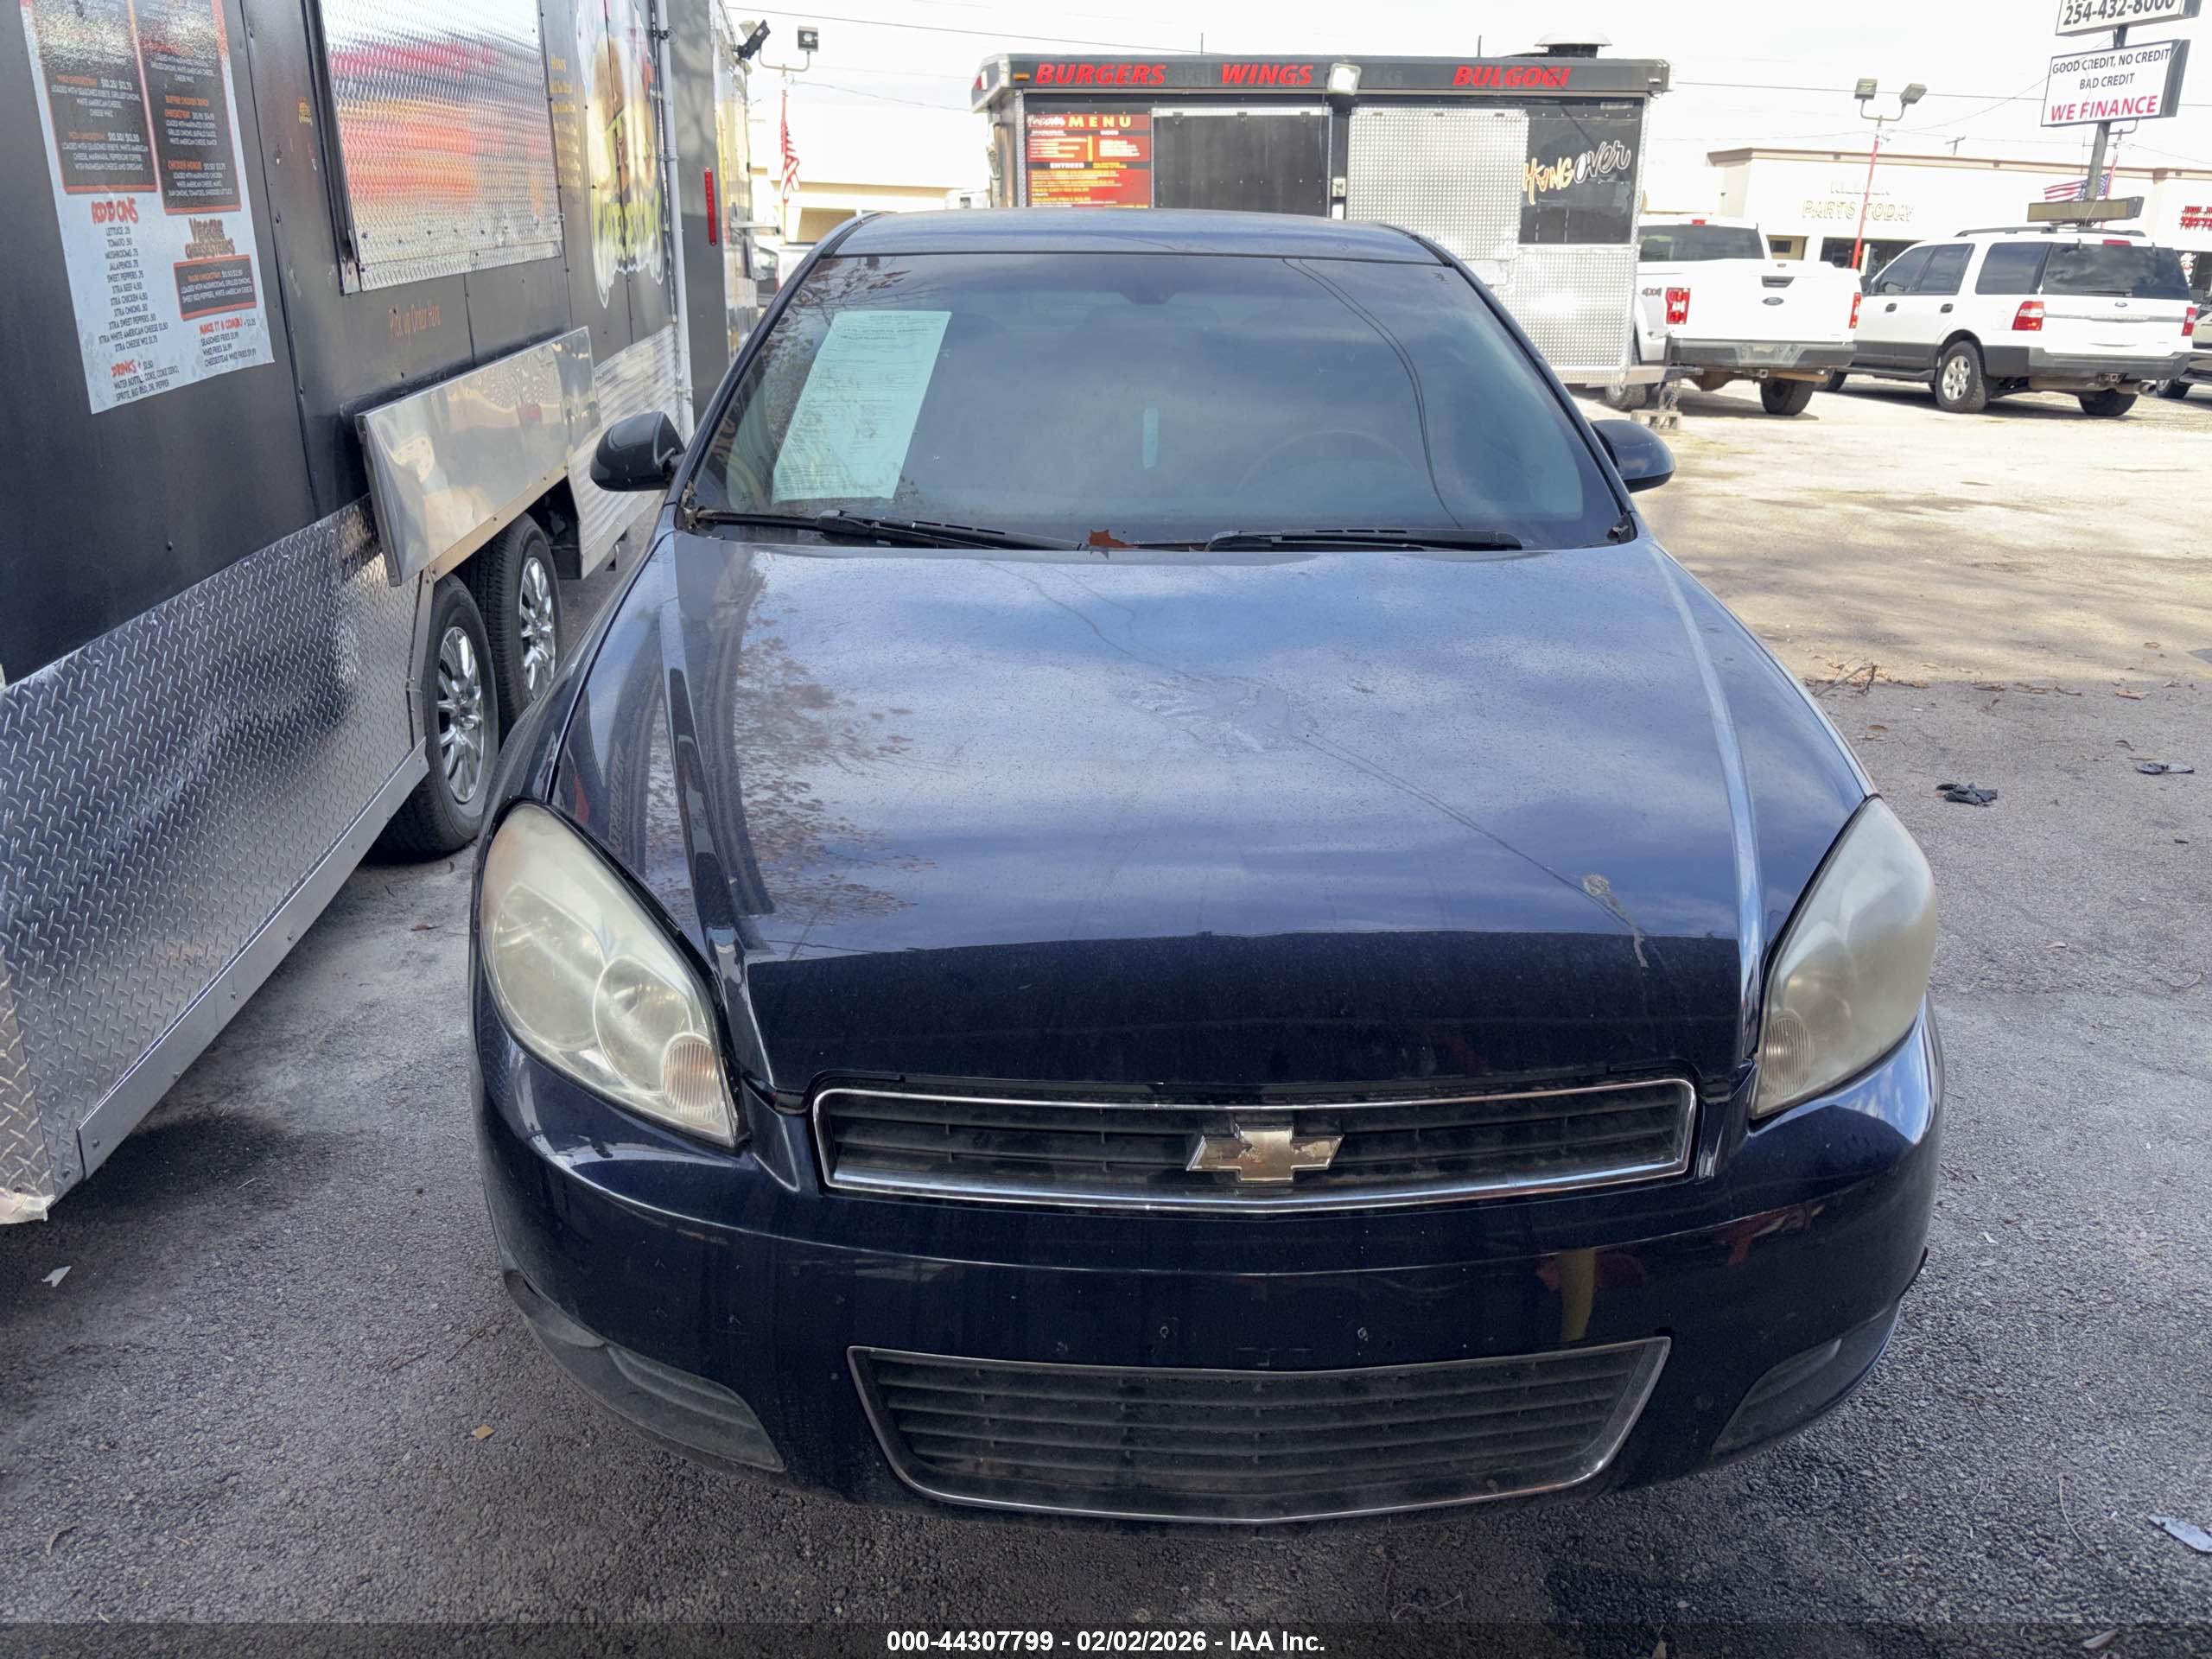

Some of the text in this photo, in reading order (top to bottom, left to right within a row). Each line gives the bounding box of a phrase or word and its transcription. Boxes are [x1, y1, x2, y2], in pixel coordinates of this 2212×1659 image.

[2052, 48, 2171, 74] GOOD CREDIT, NO CREDIT
[1035, 63, 1166, 85] BURGERS
[1221, 64, 1314, 85] WINGS
[1452, 65, 1572, 86] BULGOGI
[2079, 73, 2135, 90] BAD CREDIT
[2050, 95, 2158, 122] WE FINANCE
[1068, 116, 1132, 128] MENU
[117, 196, 138, 224] ONS
[1802, 200, 1914, 221] PARTS TODAY
[111, 359, 137, 378] DRINKS
[113, 378, 128, 390] WATER
